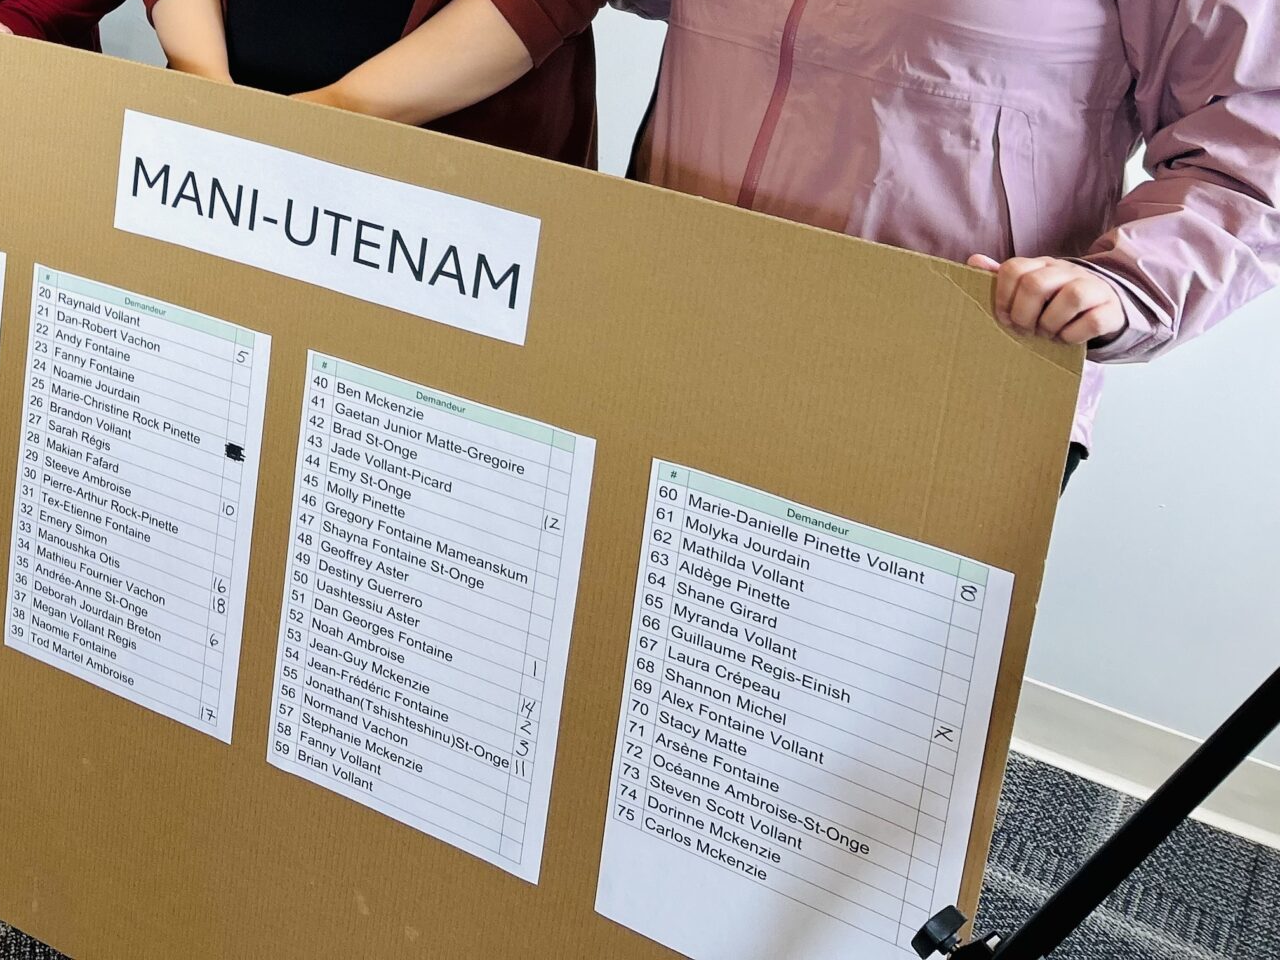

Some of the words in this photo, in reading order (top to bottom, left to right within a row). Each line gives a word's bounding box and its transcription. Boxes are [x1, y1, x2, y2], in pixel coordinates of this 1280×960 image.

[131, 156, 521, 310] MANI-UTENAM
[36, 303, 49, 317] 21
[56, 309, 117, 339] Dan-Robert
[119, 329, 160, 352] Vachon
[38, 285, 51, 299] 20
[57, 291, 101, 314] Raynald
[103, 305, 140, 327] Vollant
[124, 297, 167, 316] Demandeur
[312, 375, 328, 389] 40
[336, 381, 361, 400] Ben
[364, 390, 424, 420] Mckenzie
[416, 390, 467, 414] Demandeur
[26, 430, 40, 444] 28
[45, 436, 83, 459] Makian
[85, 451, 119, 473] Fafard
[306, 434, 323, 448] 43
[330, 441, 361, 461] Jade
[364, 451, 452, 493] Vollant-Picard
[310, 394, 325, 408] 41
[334, 401, 380, 426] Gaetan
[382, 418, 422, 440] Junior
[425, 431, 525, 475] Matte-Gregoire
[20, 501, 33, 516] 32
[38, 509, 72, 533] Emery
[74, 522, 107, 545] Simon
[23, 465, 37, 480] 30
[42, 472, 108, 506] Pierre-Arthur
[109, 498, 178, 534] Rock-Pinette
[786, 507, 850, 537] Demandeur
[300, 493, 316, 507] 46
[324, 500, 374, 530] Gregory
[377, 518, 432, 549] Fontaine
[435, 540, 528, 584] Mameanskum
[658, 484, 678, 501] 60
[688, 493, 798, 542] Marie-Danielle
[803, 532, 860, 562] Pinette
[866, 552, 925, 584] Vollant
[15, 554, 29, 568] 35
[34, 562, 102, 598] Andrée-Anne
[104, 590, 148, 617] St-Onge
[649, 549, 669, 566] 63
[678, 559, 732, 588] Aldège
[735, 578, 790, 610] Pinette
[10, 623, 24, 637] 39
[30, 631, 50, 648] Tod
[51, 640, 83, 663] Martel
[85, 656, 134, 686] Ambroise
[286, 626, 302, 642] 53
[308, 637, 368, 671] Jean-Guy
[370, 660, 430, 694] Mckenzie
[288, 607, 304, 624] 52
[311, 616, 343, 639] Noah
[346, 631, 405, 664] Ambroise
[638, 635, 658, 651] 67
[667, 644, 710, 673] Laura
[714, 663, 780, 700] Crépeau
[641, 614, 660, 631] 66
[670, 624, 746, 663] Guillaume
[750, 653, 850, 703] Regis-Einish
[282, 664, 298, 680] 55
[284, 646, 299, 661] 54
[306, 656, 390, 699] Jean-Frédéric
[393, 690, 449, 722] Fontaine
[278, 702, 294, 717] 57
[301, 711, 361, 746] Stephanie
[364, 738, 423, 773] Mckenzie
[633, 677, 652, 694] 69
[660, 689, 694, 712] Alex
[698, 702, 765, 740] Fontaine
[769, 730, 824, 764] Vollant
[628, 719, 644, 737] 71
[654, 732, 708, 763] Arsène
[712, 754, 779, 792] Fontaine
[622, 762, 640, 780] 73
[649, 774, 701, 806] Steven
[705, 797, 745, 825] Scott
[749, 814, 802, 850] Vollant
[625, 740, 643, 759] 72
[652, 753, 720, 791] Océanne
[723, 783, 869, 855] Ambroise-St-Onge
[617, 803, 635, 821] 75
[644, 816, 691, 847] Carlos
[695, 837, 767, 880] Mckenzie
